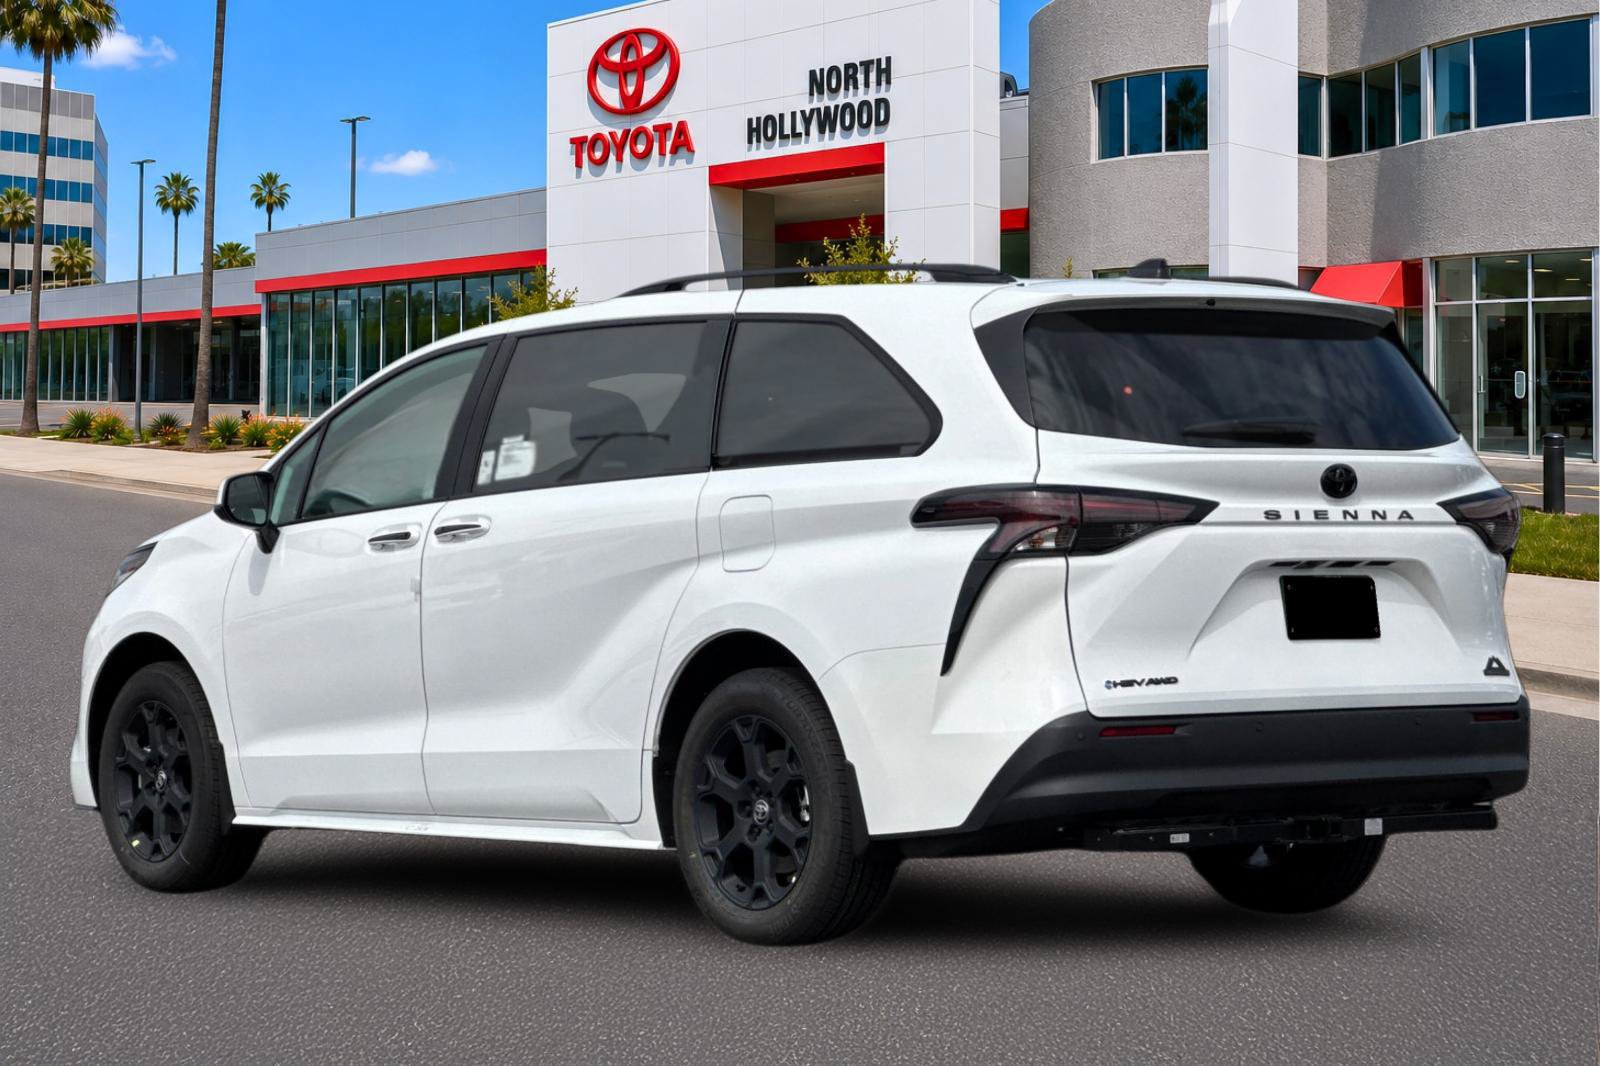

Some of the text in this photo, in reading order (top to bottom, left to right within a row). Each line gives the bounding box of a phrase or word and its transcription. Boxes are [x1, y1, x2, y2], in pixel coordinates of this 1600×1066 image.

[808, 55, 892, 97] NORTH
[746, 97, 891, 145] HOLLYWOOD
[569, 120, 695, 168] TOYOTA
[1263, 509, 1414, 521] SIENNA
[1145, 676, 1179, 686] AWD
